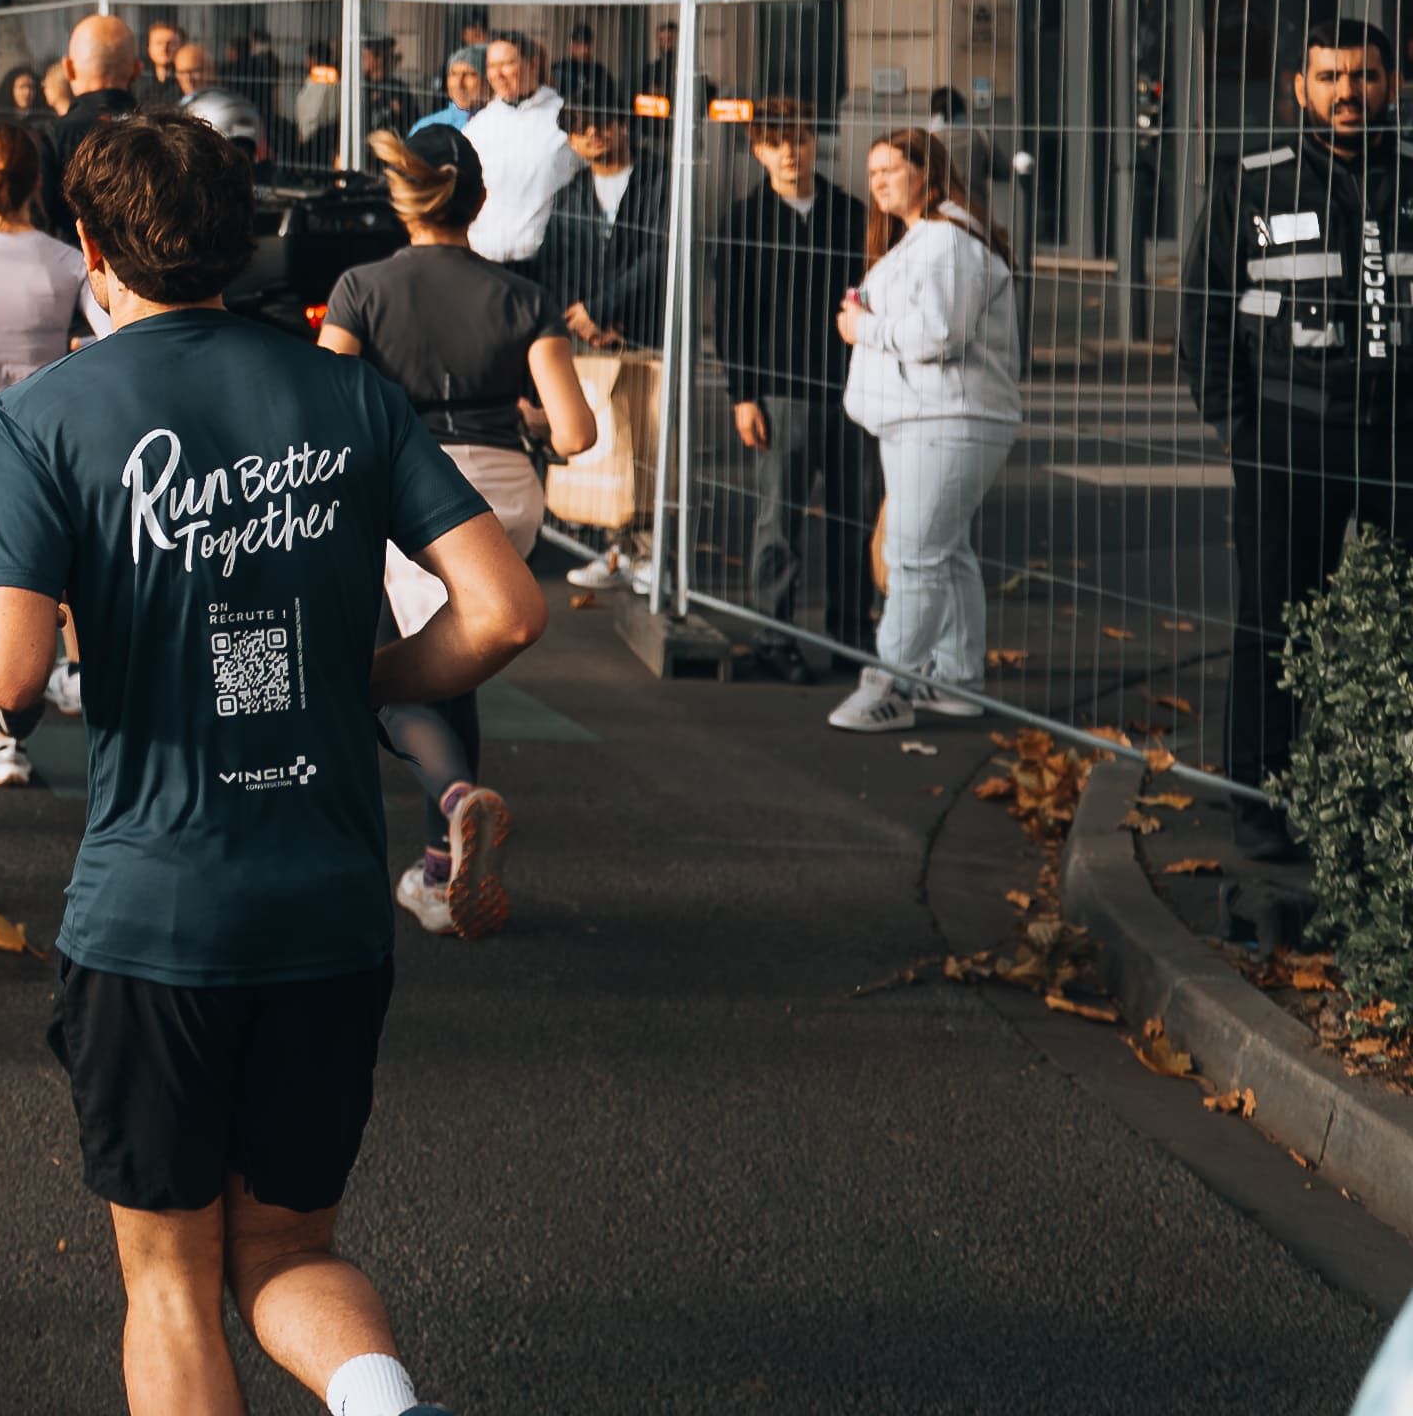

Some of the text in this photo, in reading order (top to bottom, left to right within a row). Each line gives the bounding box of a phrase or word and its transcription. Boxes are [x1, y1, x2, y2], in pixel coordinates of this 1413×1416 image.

[121, 427, 352, 565] Run Better
[174, 492, 340, 578] Together
[208, 602, 228, 613] ON
[209, 609, 275, 625] RECRUTE
[219, 767, 284, 783] VINCI
